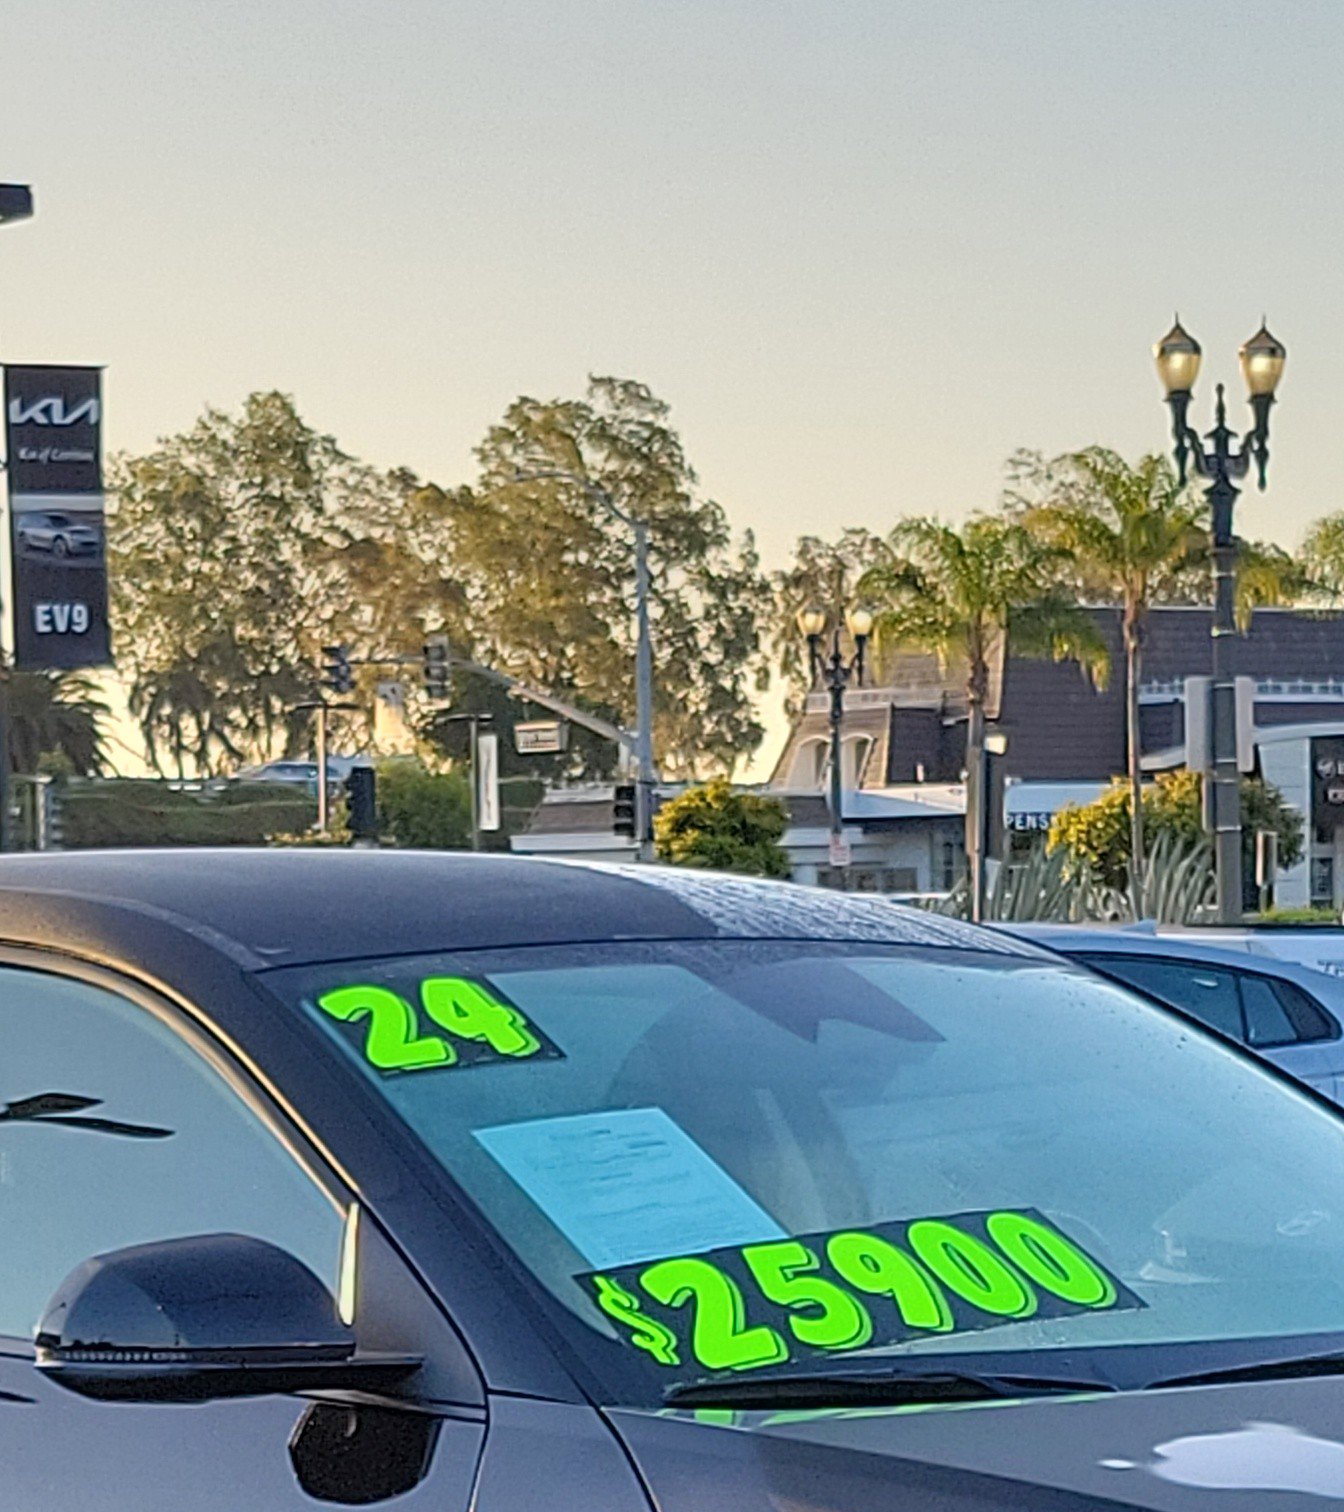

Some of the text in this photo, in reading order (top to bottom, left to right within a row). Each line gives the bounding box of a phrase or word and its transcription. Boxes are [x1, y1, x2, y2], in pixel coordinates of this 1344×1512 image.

[8, 397, 99, 425] KIA
[36, 603, 89, 632] EV9
[318, 977, 542, 1072] 24
[593, 1211, 1118, 1371] $25900
